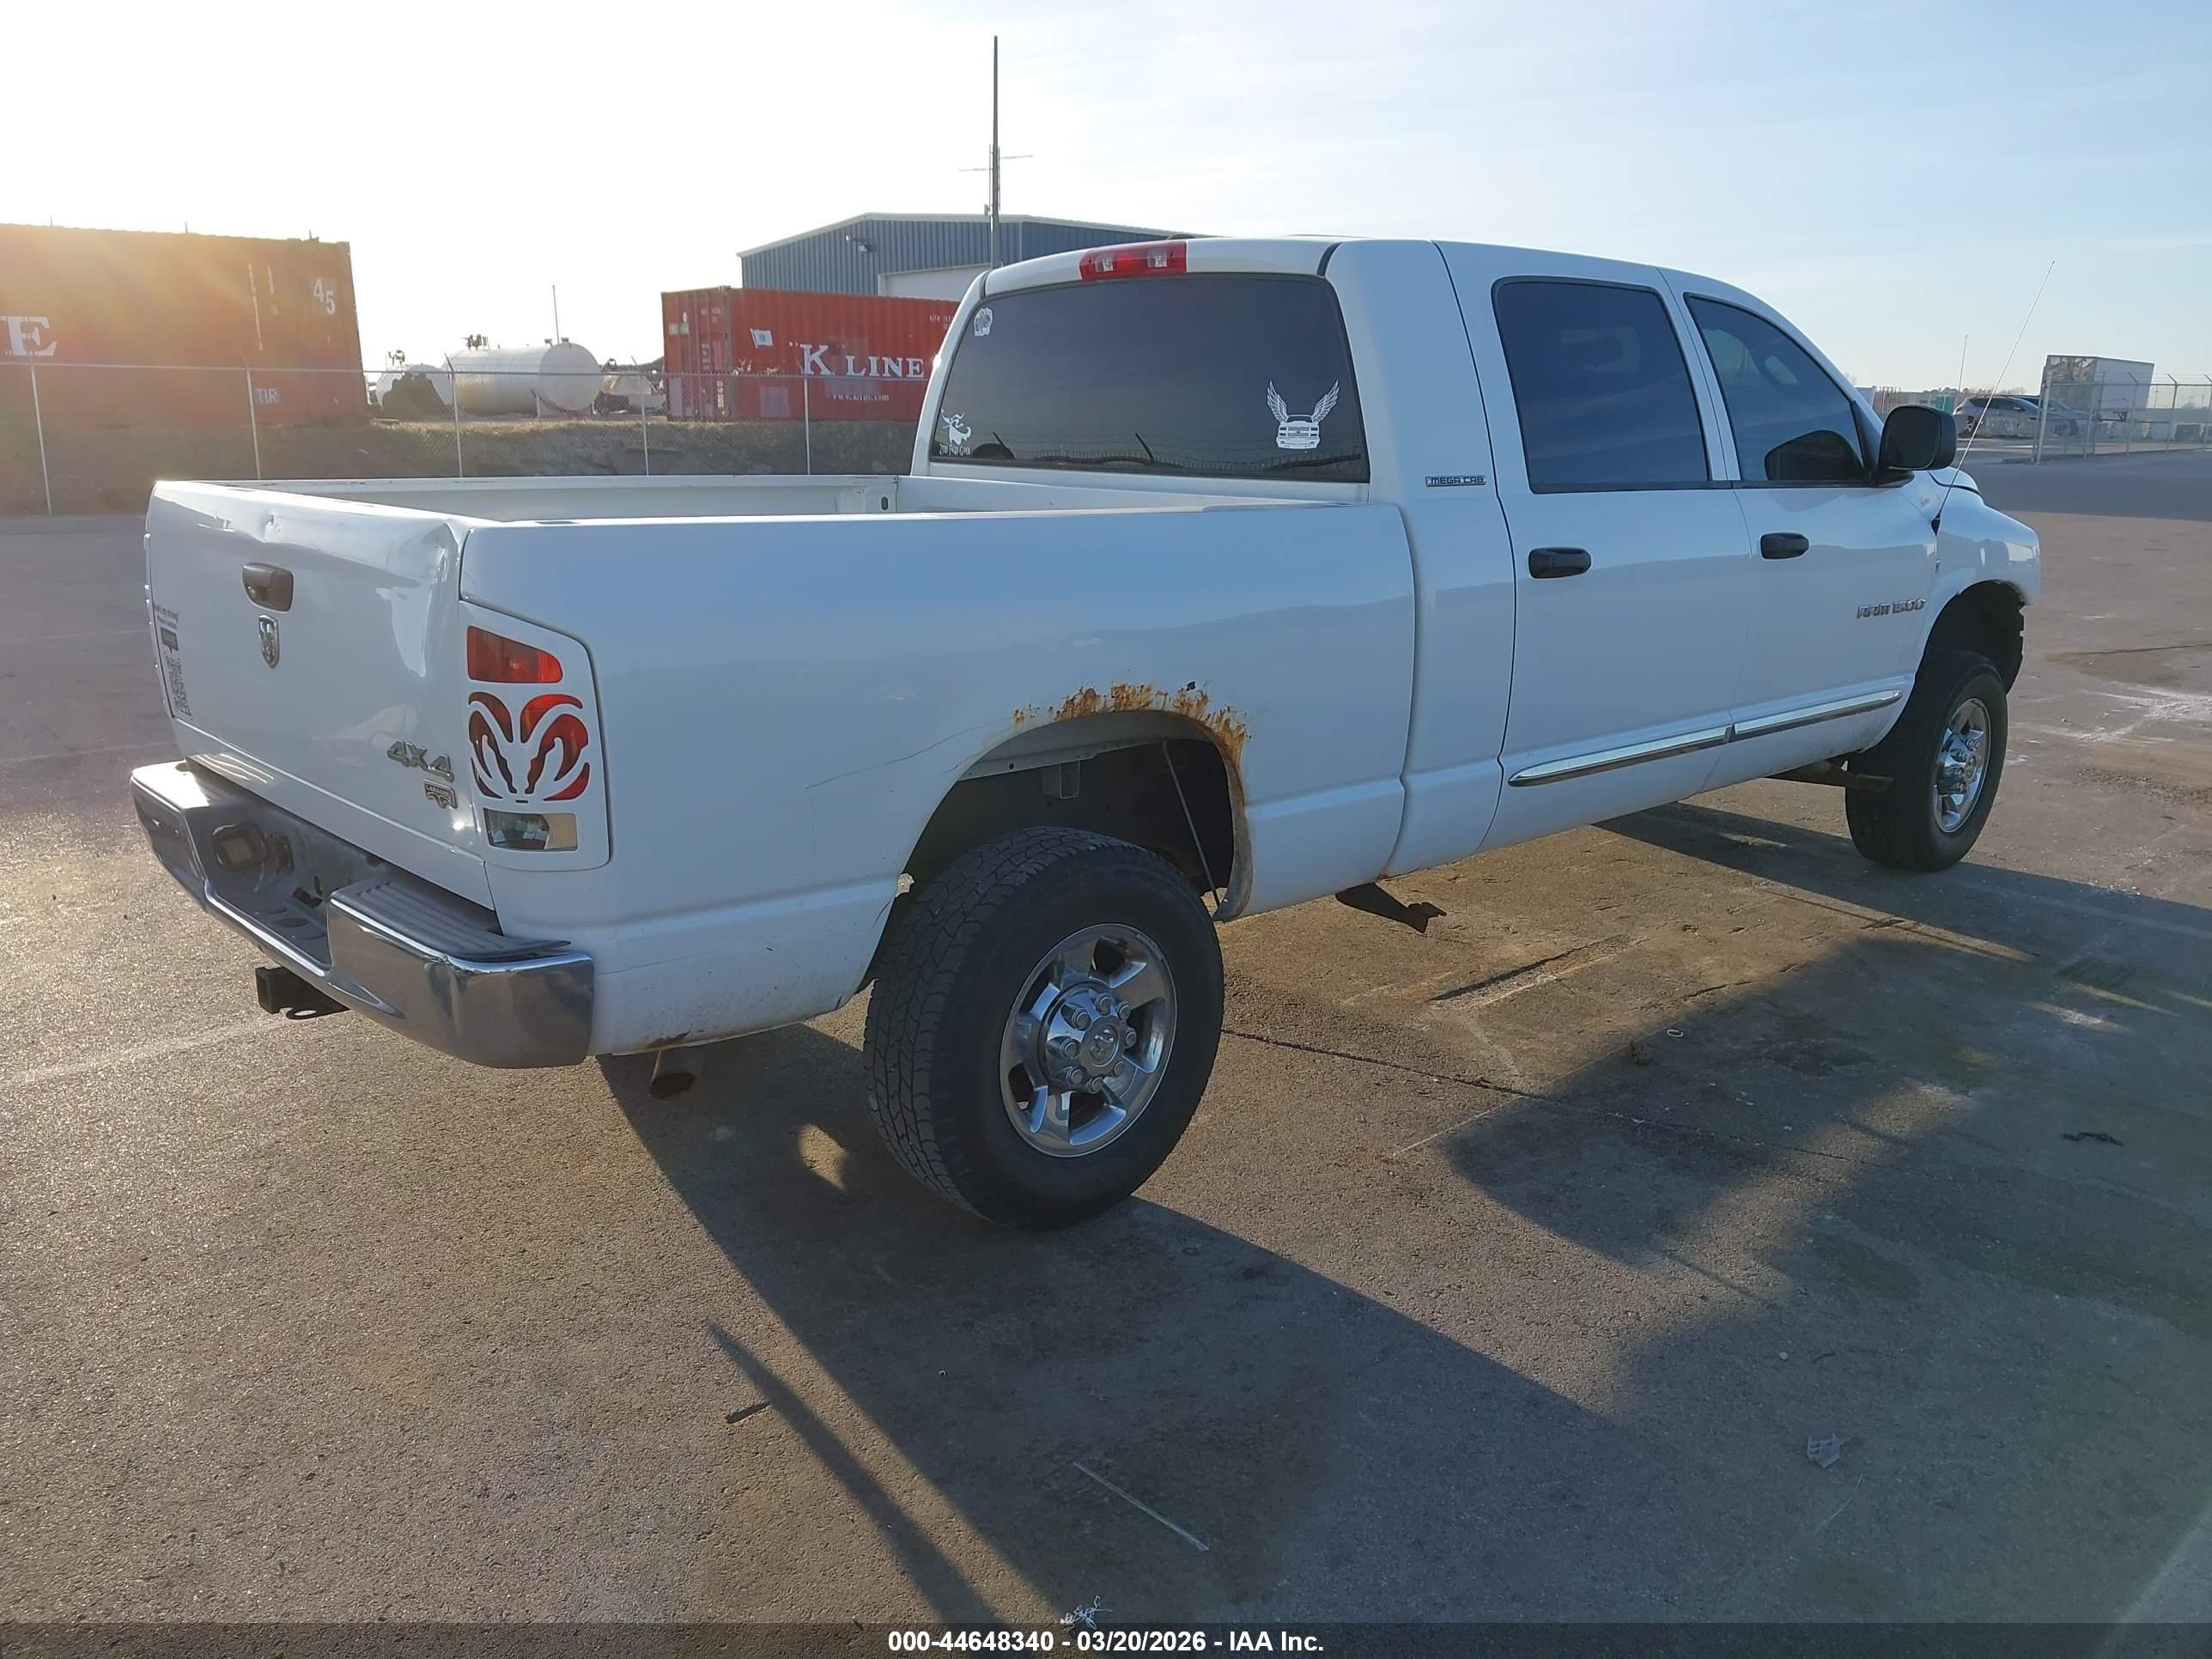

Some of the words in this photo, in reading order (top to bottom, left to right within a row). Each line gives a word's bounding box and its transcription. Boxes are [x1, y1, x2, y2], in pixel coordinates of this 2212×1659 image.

[313, 277, 337, 316] 45
[0, 315, 58, 356] E
[846, 355, 925, 379] LINE
[257, 388, 278, 404] TIR
[1431, 477, 1461, 485] MEGA
[1463, 476, 1484, 484] CAB
[1856, 603, 1891, 619] RAM
[1892, 598, 1926, 614] 1500
